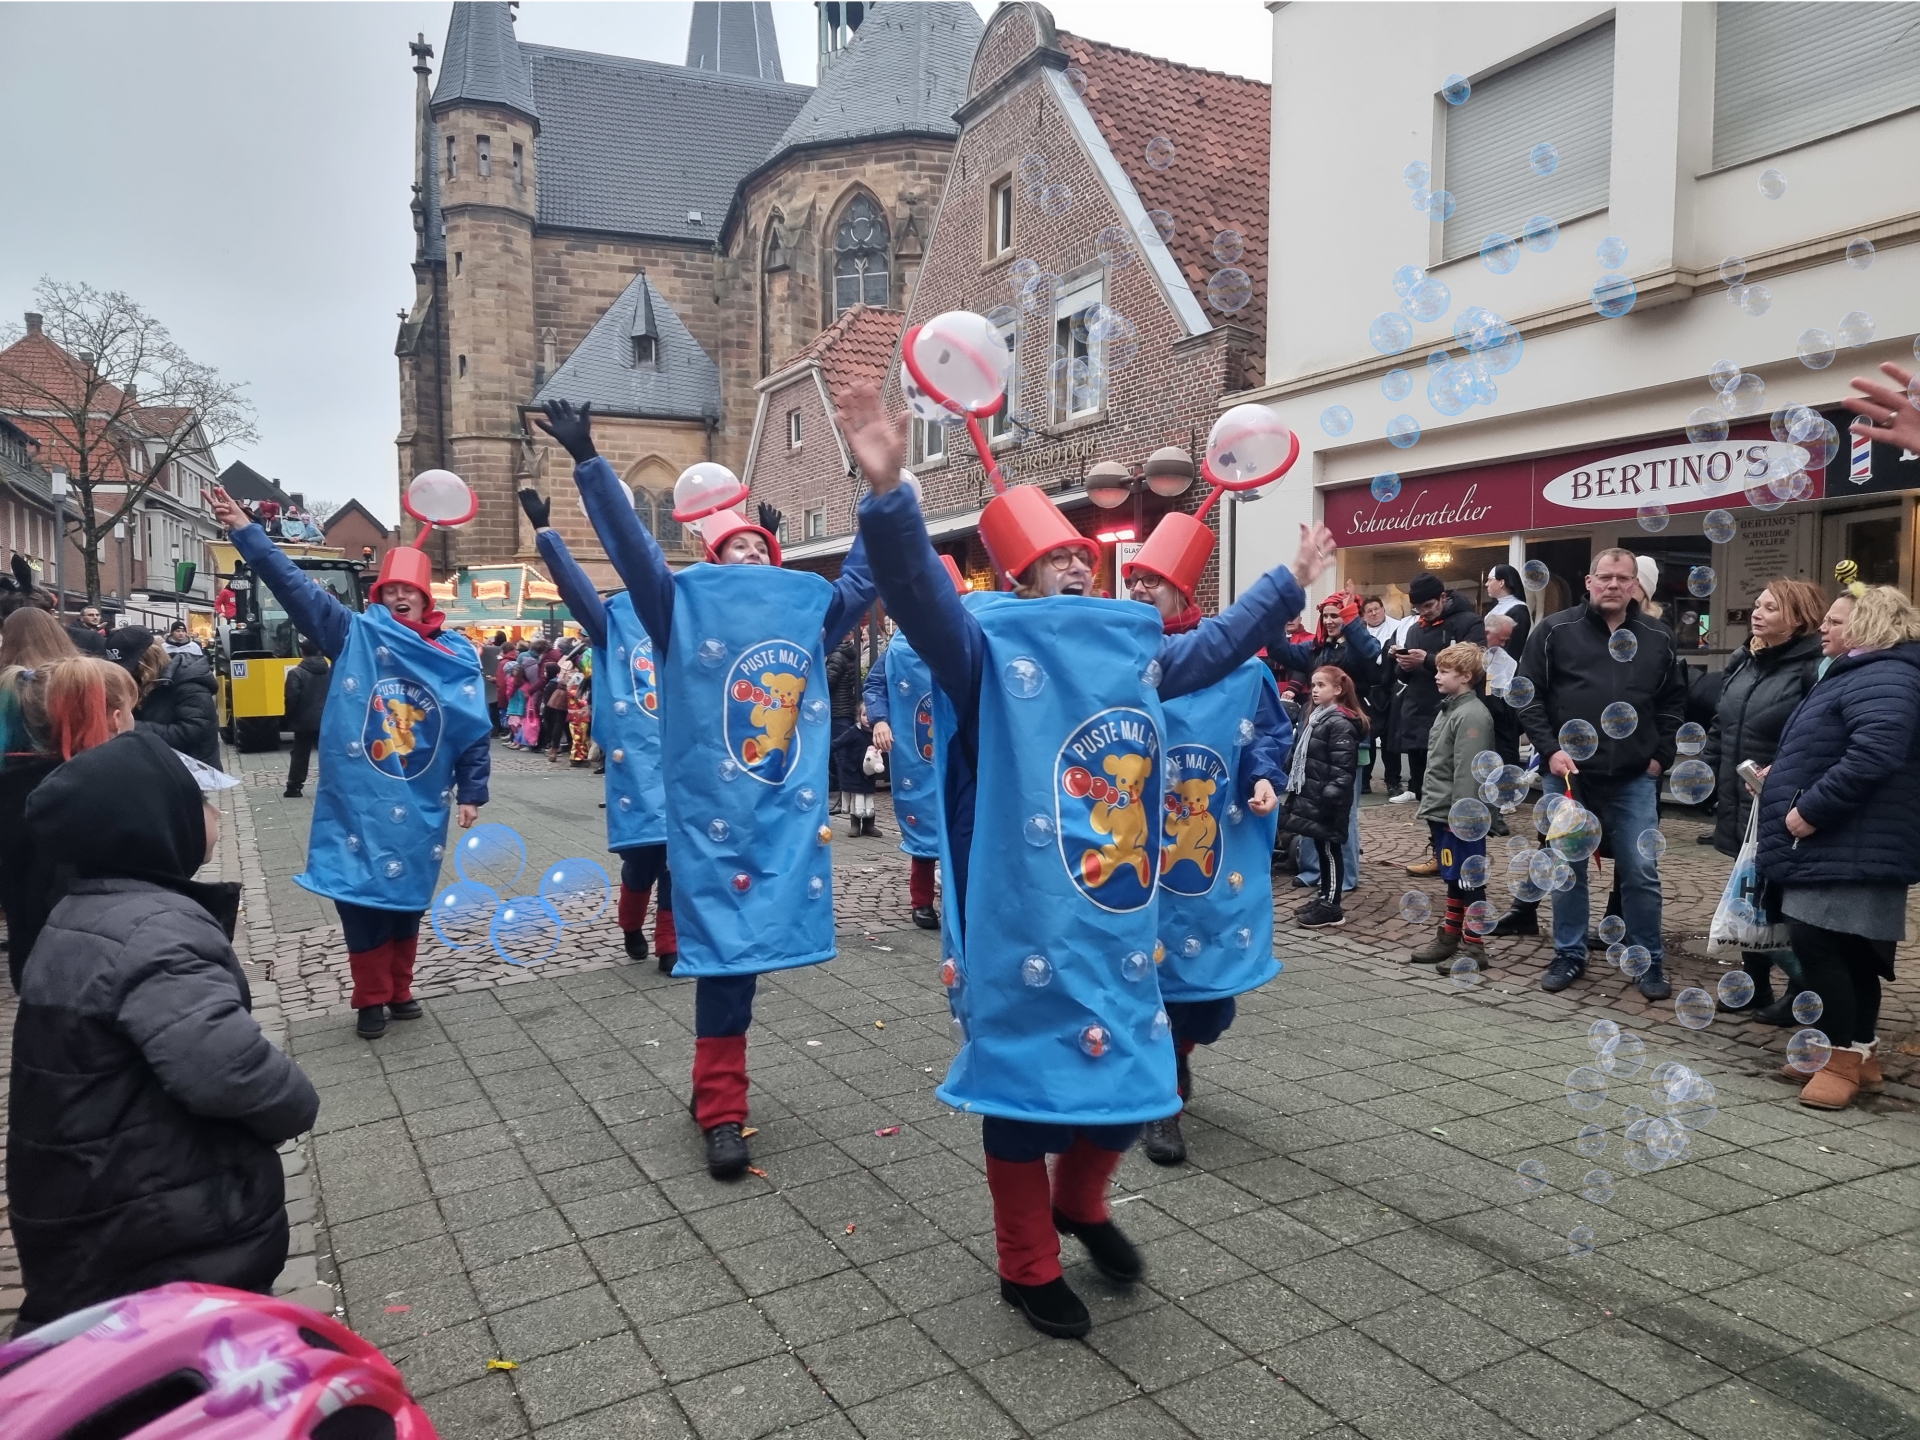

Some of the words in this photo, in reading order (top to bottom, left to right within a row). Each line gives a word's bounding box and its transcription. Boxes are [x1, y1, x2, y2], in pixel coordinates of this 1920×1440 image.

[1571, 445, 1770, 500] BERTINO'S
[1347, 483, 1492, 535] Schneideratelier
[1740, 516, 1796, 529] BERTINO'S
[1748, 538, 1786, 547] ATELIER
[1735, 610, 1743, 621] 3
[740, 649, 776, 676] PUSTE
[779, 648, 799, 669] MAL
[418, 697, 436, 714] FIX
[1072, 721, 1119, 761] PUSTE
[1120, 720, 1145, 745] MAL
[1185, 753, 1208, 771] MAL
[1207, 760, 1222, 781] FIX
